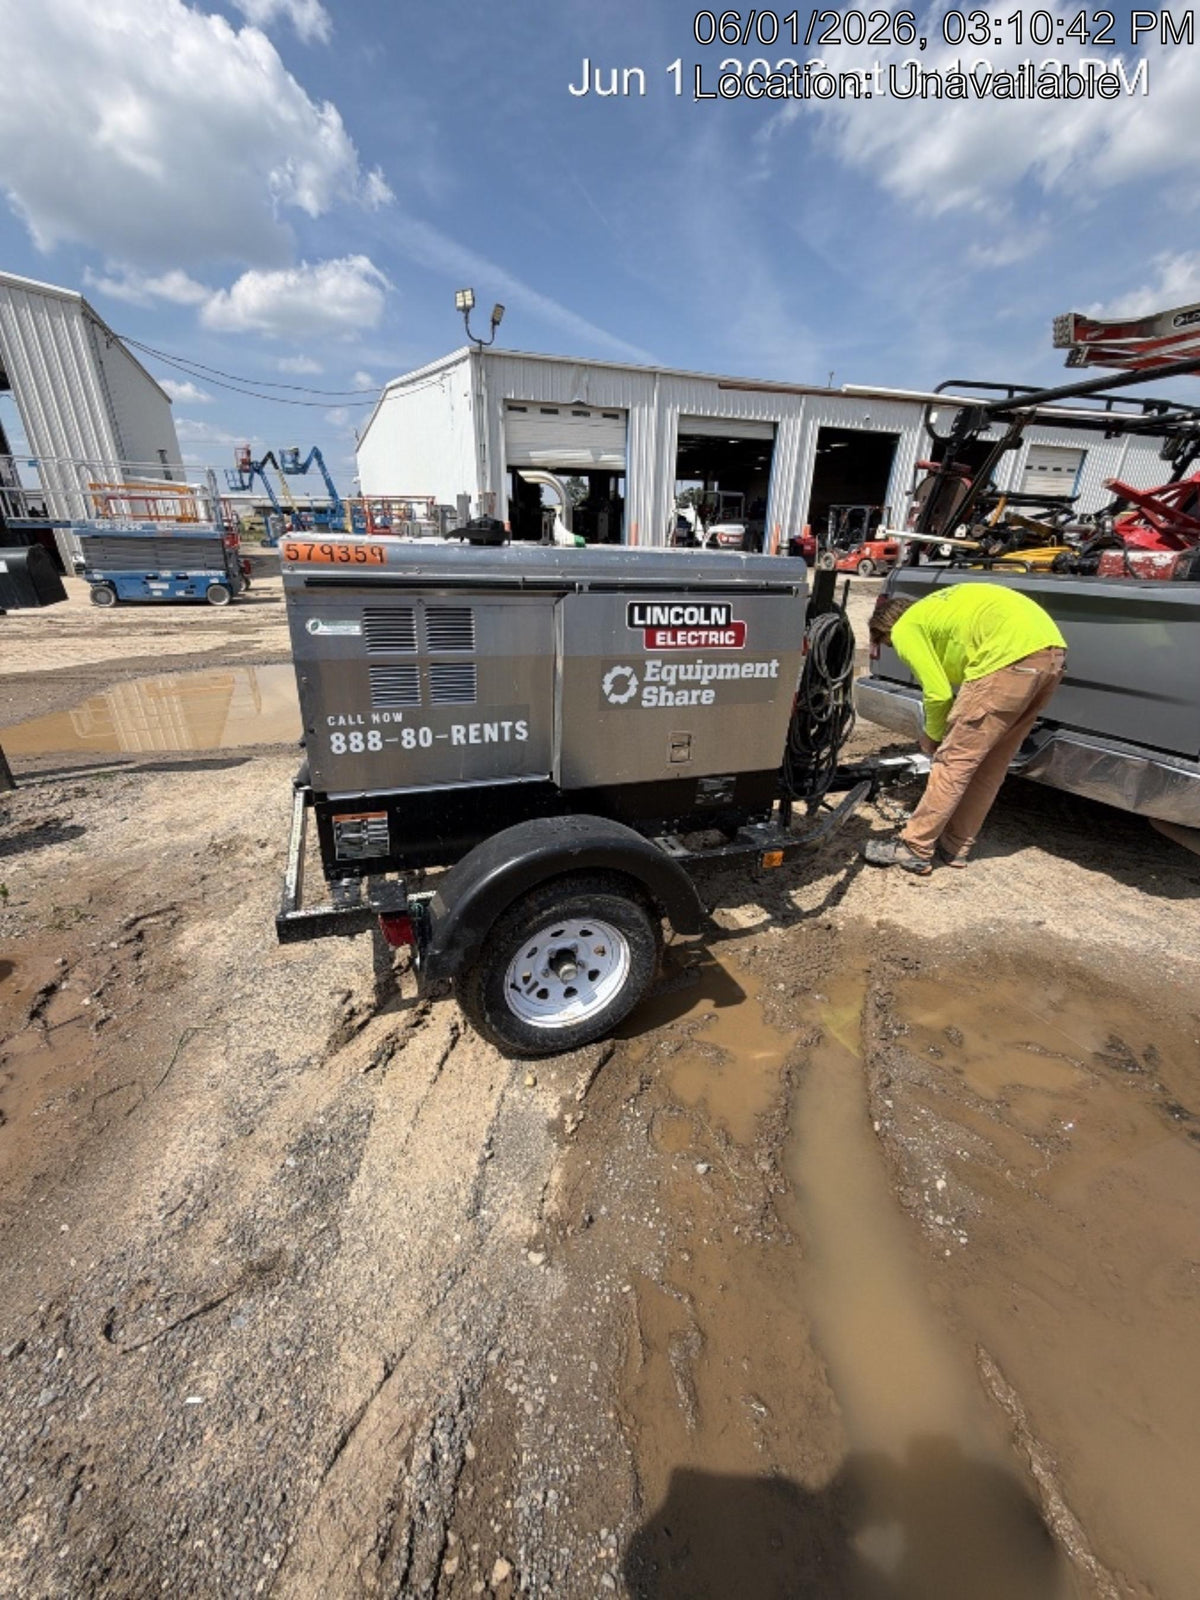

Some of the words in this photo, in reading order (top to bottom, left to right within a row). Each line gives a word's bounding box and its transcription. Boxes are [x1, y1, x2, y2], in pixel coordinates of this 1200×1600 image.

[286, 543, 385, 563] 579359
[633, 605, 727, 626] LINCOLN
[655, 630, 736, 646] ELECTRIC
[643, 658, 779, 686] Equipment
[641, 685, 716, 708] Share
[327, 713, 365, 726] CALL
[371, 711, 403, 724] NOW
[329, 720, 529, 755] 888-80-RENTS
